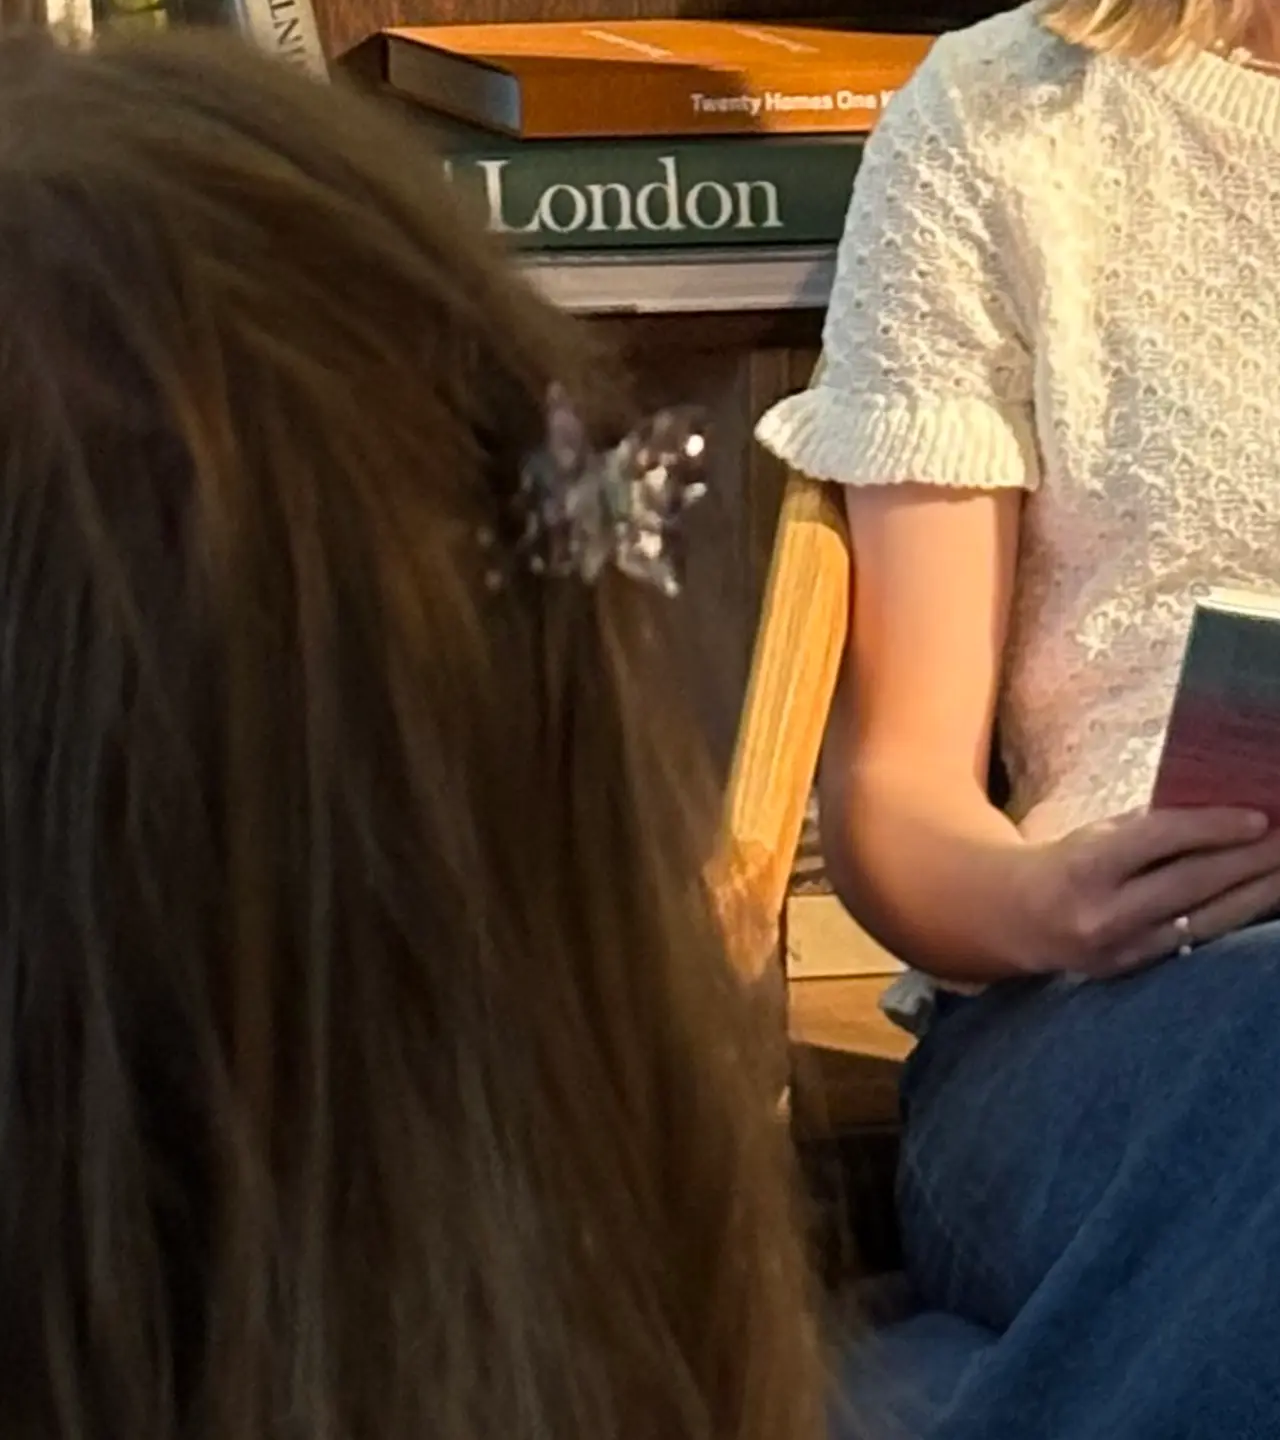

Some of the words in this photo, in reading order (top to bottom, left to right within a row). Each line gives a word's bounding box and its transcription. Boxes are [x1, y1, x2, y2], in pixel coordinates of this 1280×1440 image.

[690, 92, 762, 117] Twenty
[765, 91, 833, 111] Homes
[837, 90, 877, 109] One
[477, 157, 784, 234] London
